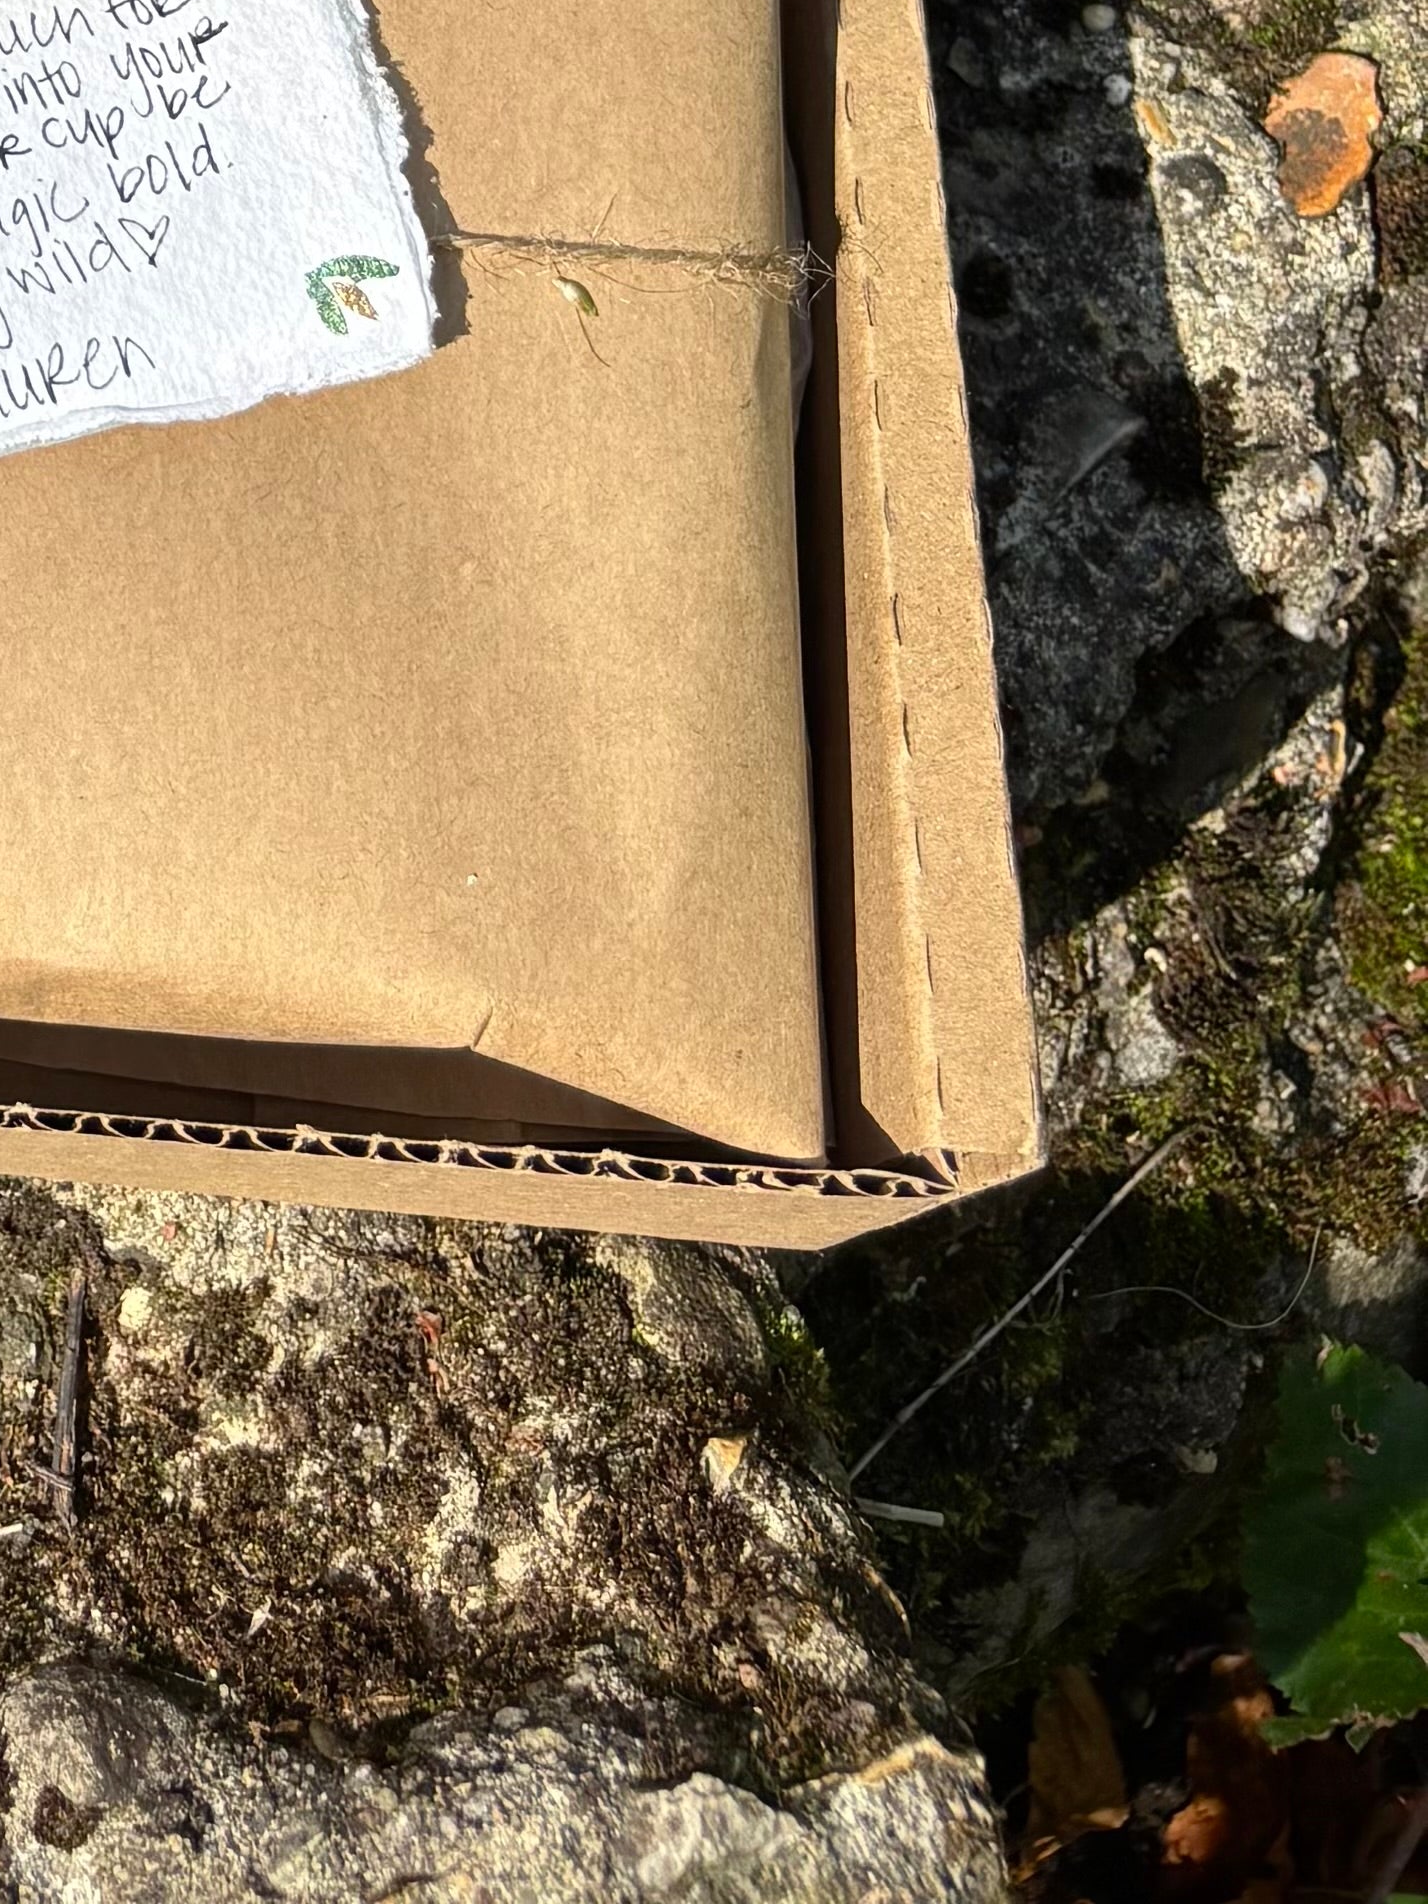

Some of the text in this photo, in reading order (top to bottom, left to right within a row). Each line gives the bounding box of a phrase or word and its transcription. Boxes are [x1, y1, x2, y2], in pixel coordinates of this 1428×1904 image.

[1, 59, 82, 115] into
[41, 105, 125, 160] cup
[157, 74, 232, 120] be
